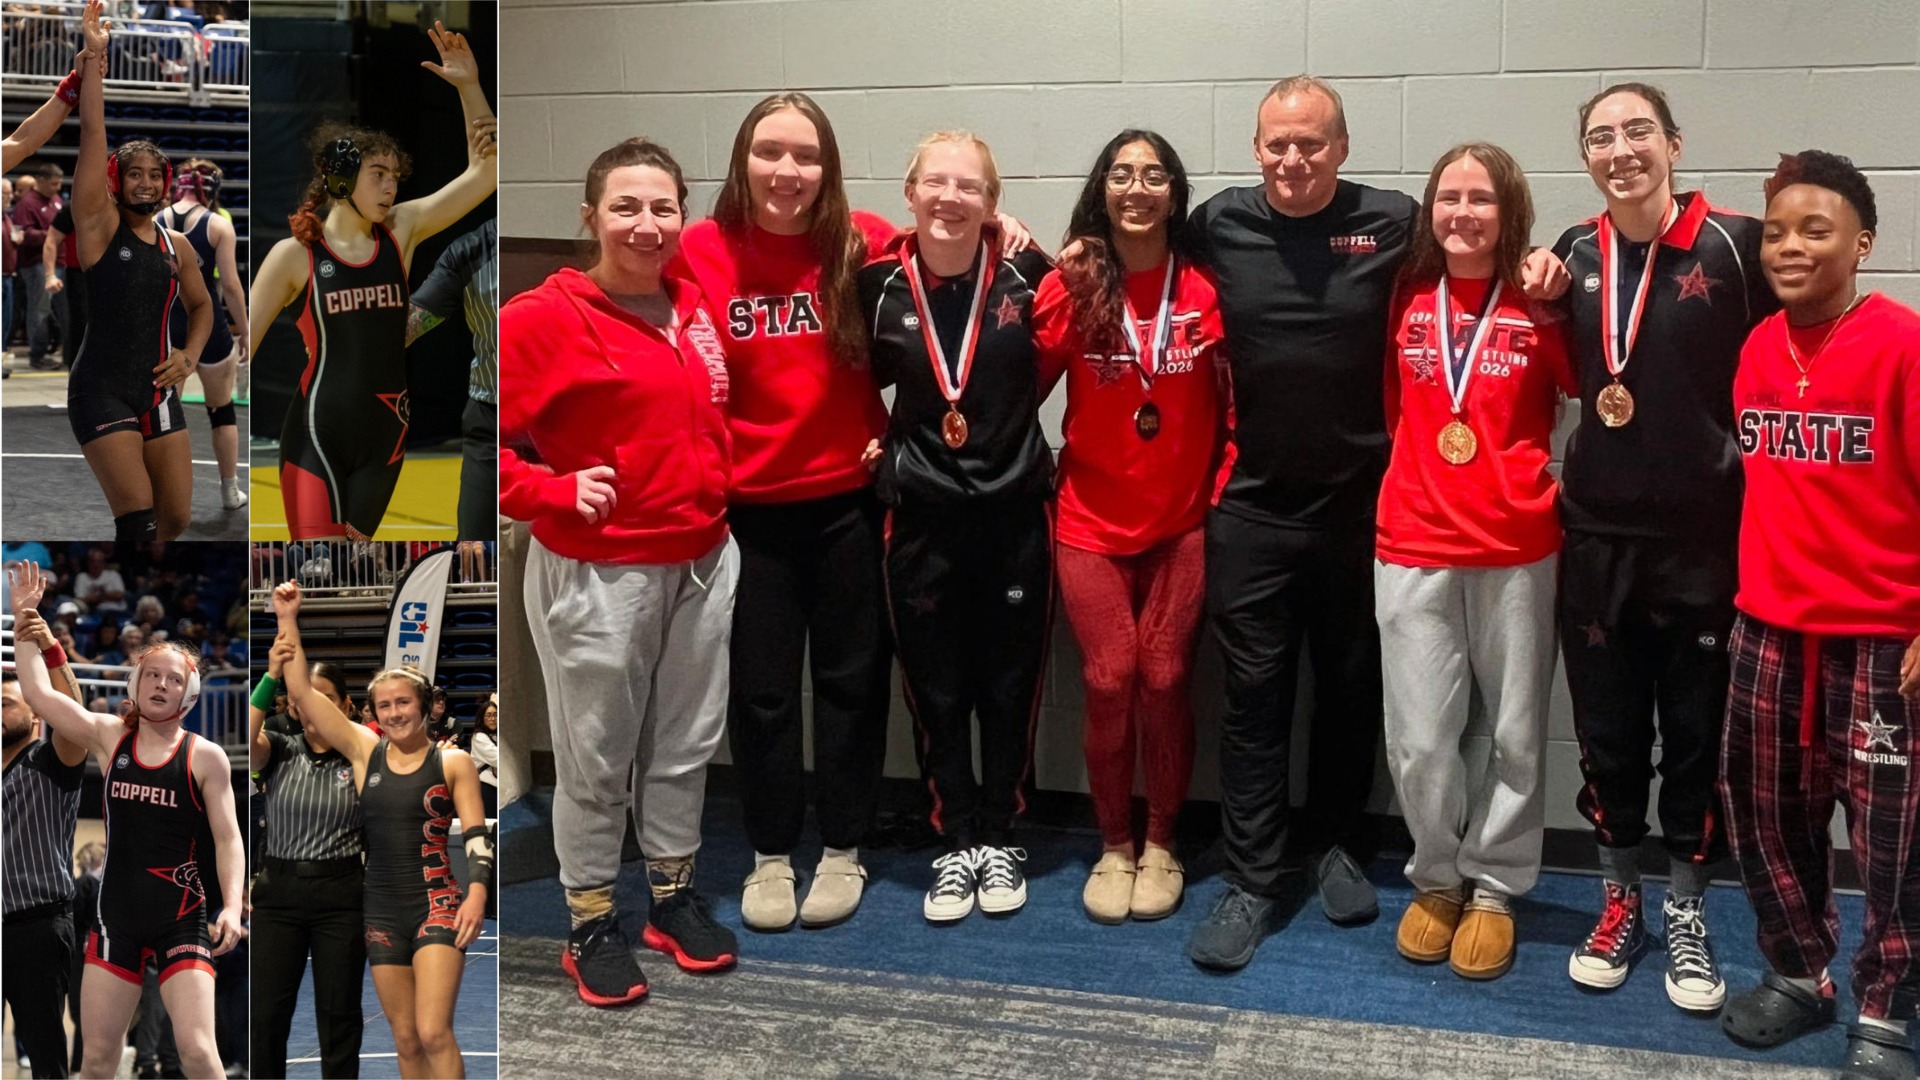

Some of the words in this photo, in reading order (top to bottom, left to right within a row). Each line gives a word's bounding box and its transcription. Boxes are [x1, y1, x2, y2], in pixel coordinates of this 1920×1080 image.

[324, 283, 404, 315] COPPELL
[728, 292, 824, 341] STA
[1480, 361, 1511, 377] 026
[1482, 349, 1529, 367] STLING
[1740, 408, 1875, 463] STATE
[398, 602, 429, 648] UIL
[1854, 749, 1908, 766] WRESTLING
[111, 781, 178, 808] COPPELL
